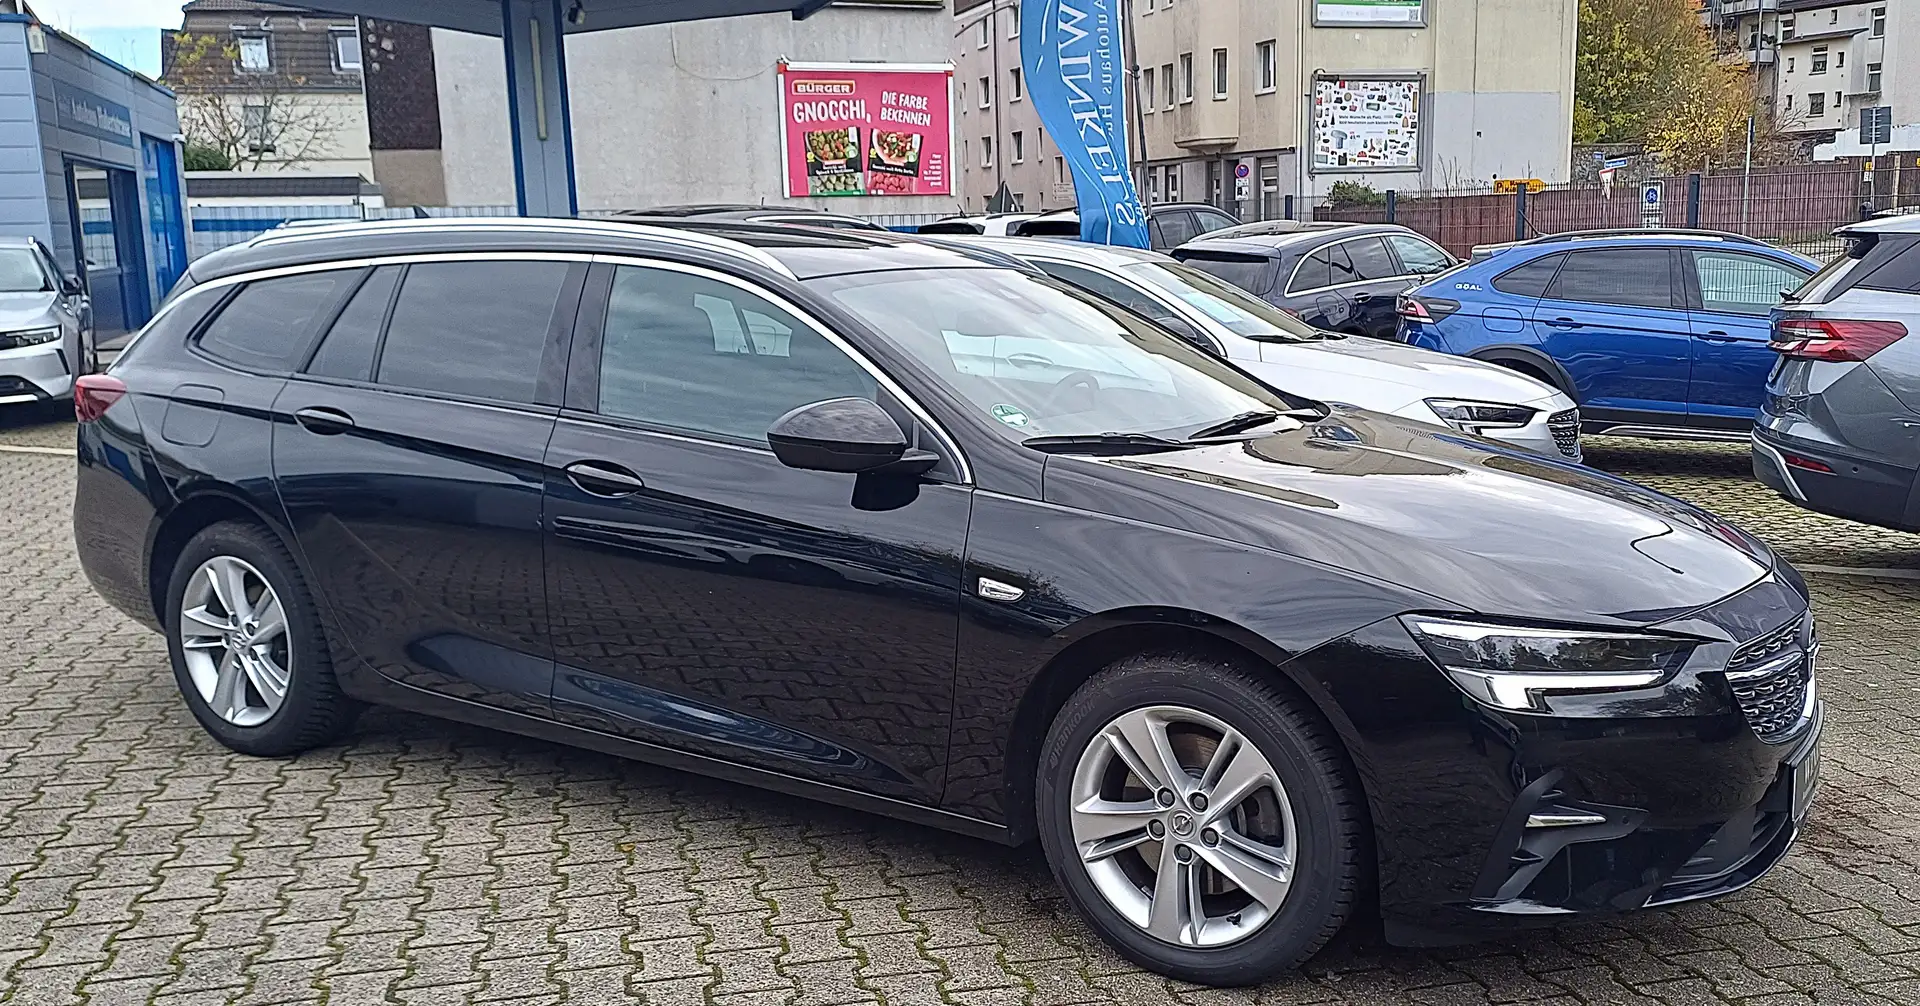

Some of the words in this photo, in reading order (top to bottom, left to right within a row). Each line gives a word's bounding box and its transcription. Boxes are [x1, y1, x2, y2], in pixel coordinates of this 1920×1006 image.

[797, 83, 850, 93] BÜRGER
[882, 91, 896, 105] DIE
[899, 93, 928, 111] FARBE
[793, 99, 871, 123] GNOCCHI,
[880, 107, 931, 126] BEKENNEN
[1455, 283, 1483, 291] GOAL
